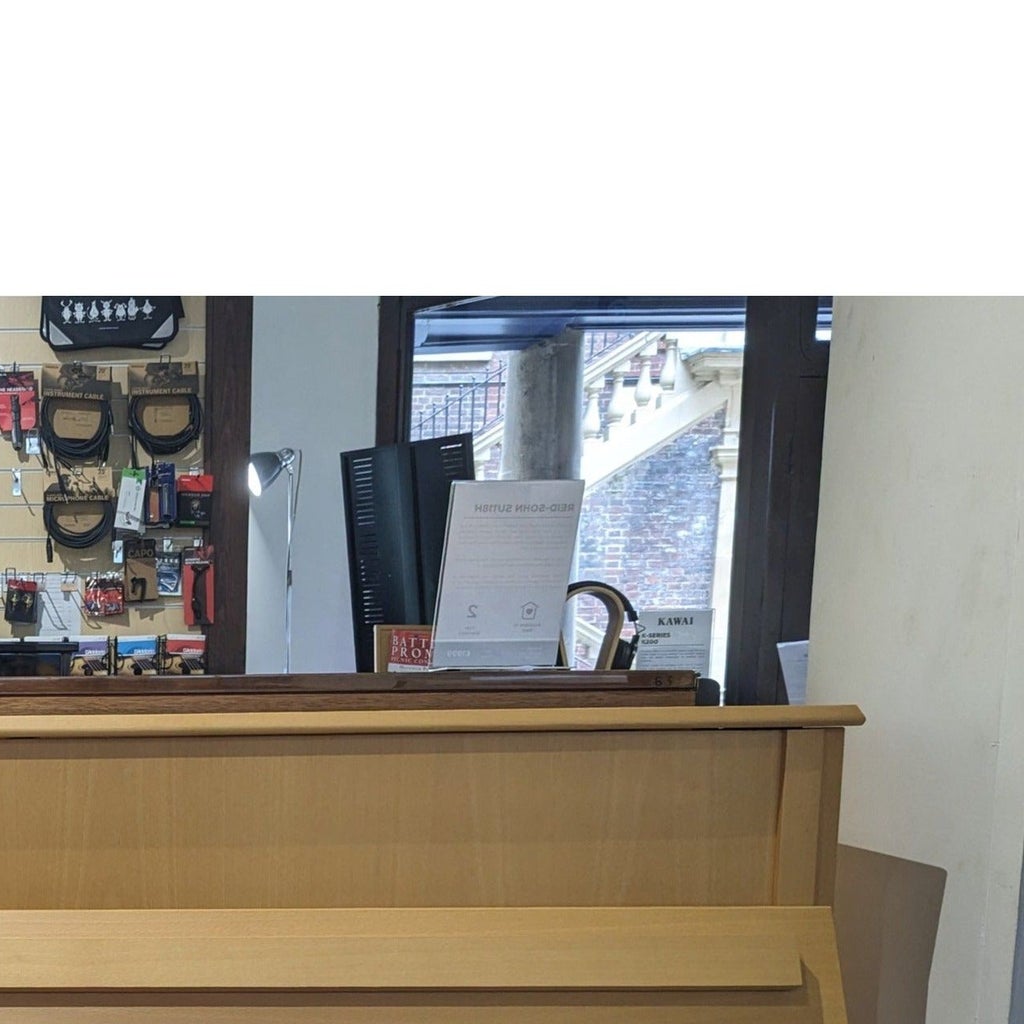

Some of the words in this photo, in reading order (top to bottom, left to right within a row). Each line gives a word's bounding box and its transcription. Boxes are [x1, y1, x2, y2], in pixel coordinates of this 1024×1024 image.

[43, 390, 83, 399] INSTRUMENT
[128, 549, 154, 558] CAPO
[658, 617, 694, 626] KAWAI
